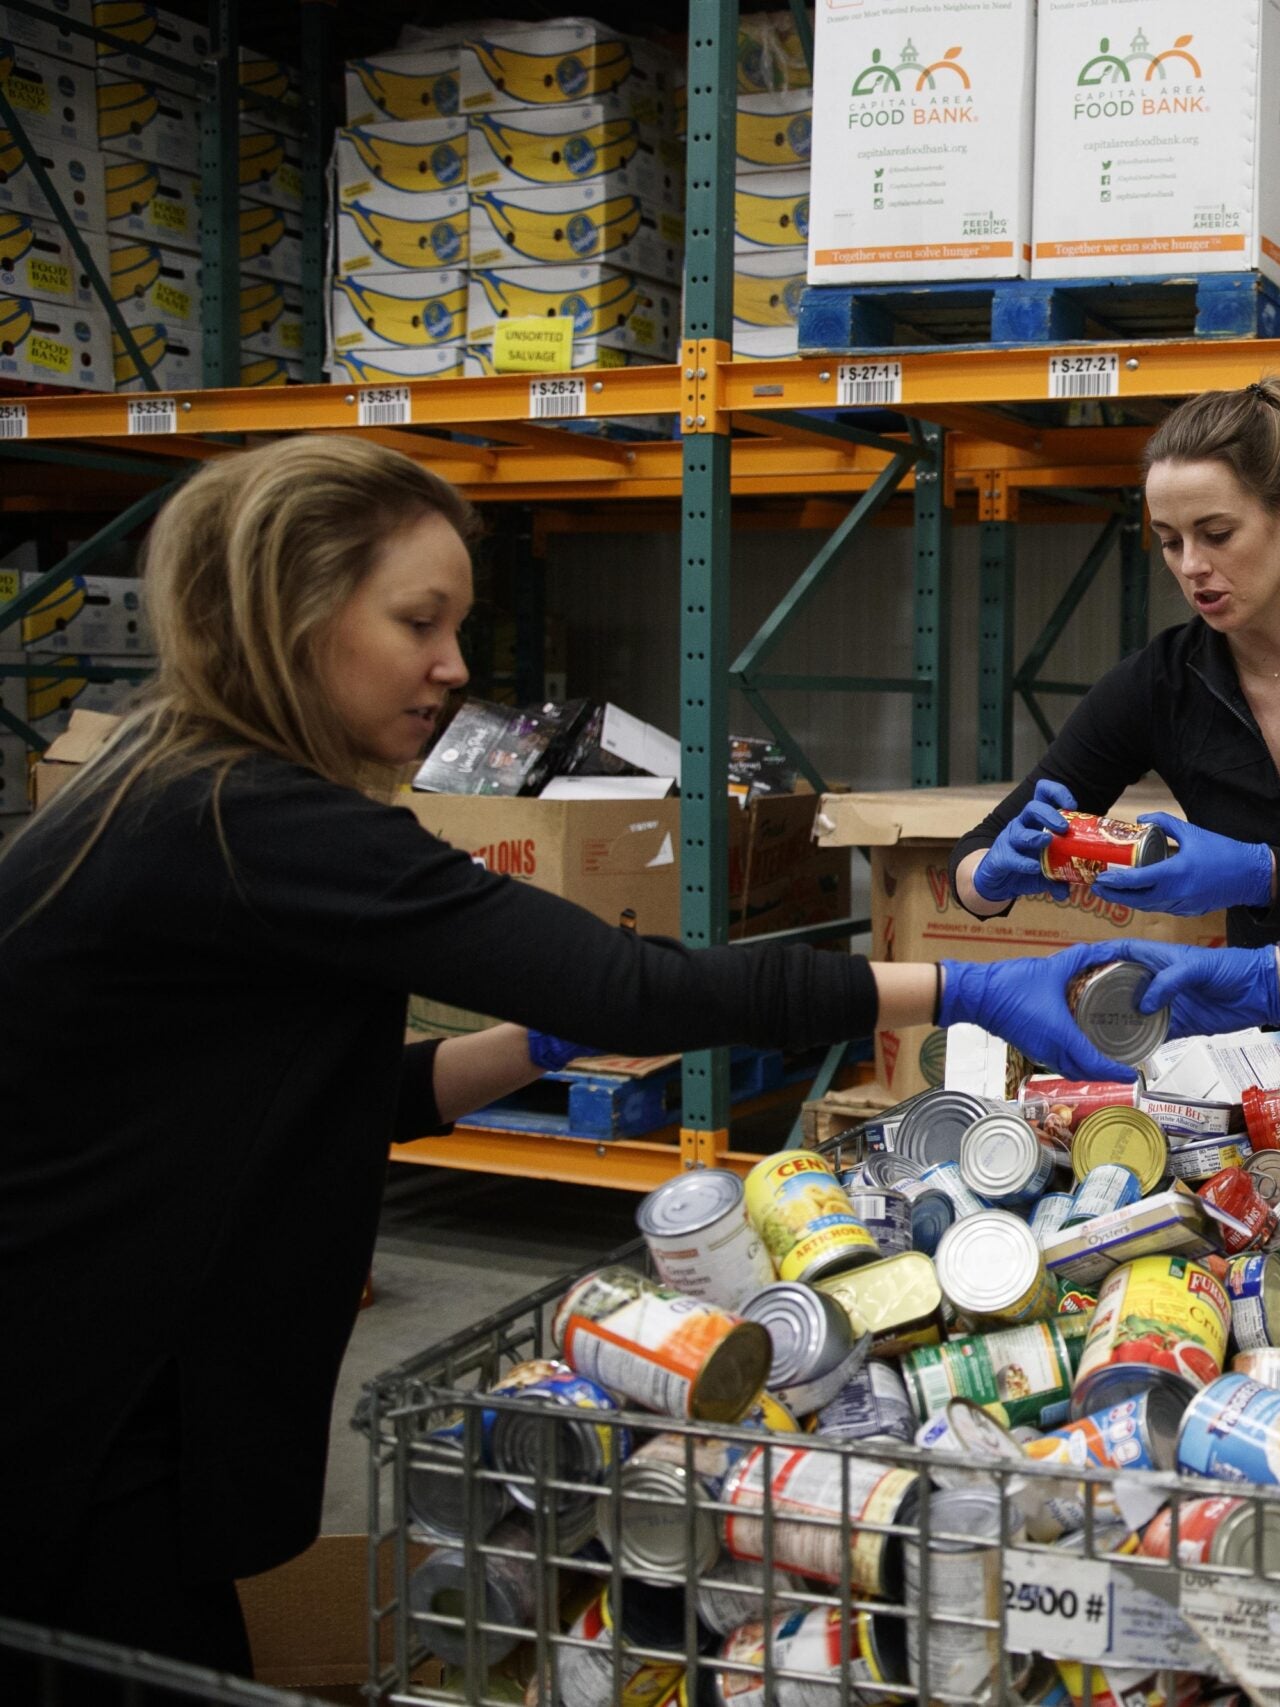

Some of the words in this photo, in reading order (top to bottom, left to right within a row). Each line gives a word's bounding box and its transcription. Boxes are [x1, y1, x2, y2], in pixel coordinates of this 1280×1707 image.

[1074, 89, 1147, 102] CAPITAL
[1161, 85, 1206, 95] AREA
[849, 99, 917, 112] CAPITAL
[930, 95, 974, 105] AREA
[1074, 100, 1134, 120] FOOD
[1142, 96, 1204, 116] BANK
[849, 109, 905, 129] FOOD
[913, 107, 973, 125] BANK
[1083, 135, 1199, 151] capitalareafoodbank.org
[857, 144, 968, 160] capitalareafoodbank.org
[963, 218, 1007, 227] FEEDING
[1193, 211, 1240, 221] FEEDING
[962, 227, 1007, 236] AMERICA
[1193, 220, 1240, 229] AMERICA
[832, 250, 877, 263] Together
[878, 250, 893, 259] we
[894, 249, 913, 259] can
[914, 246, 942, 257] solve
[1055, 243, 1100, 255] Together
[1103, 243, 1119, 252] we
[1120, 242, 1139, 251] can
[1142, 240, 1169, 250] solve
[29, 261, 68, 276] FOOD
[31, 272, 68, 286] BANK
[505, 329, 564, 343] UNSORTED
[30, 338, 69, 355] FOOD
[30, 350, 69, 366] BANK
[507, 350, 557, 363] SALVAGE
[1061, 357, 1107, 373] S-27-2
[849, 366, 890, 381] S-27-1
[539, 381, 576, 396] S-26-2
[367, 390, 401, 404] S-26-1
[0, 406, 19, 419] 25-1
[137, 401, 168, 414] S-25-2
[927, 922, 966, 932] PRODUCT
[1023, 929, 1060, 939] MEXICO
[1147, 1102, 1184, 1118] BUMBLE
[1185, 1107, 1204, 1122] BEE
[1088, 1223, 1131, 1246] Oysters
[1086, 1594, 1104, 1623] #
